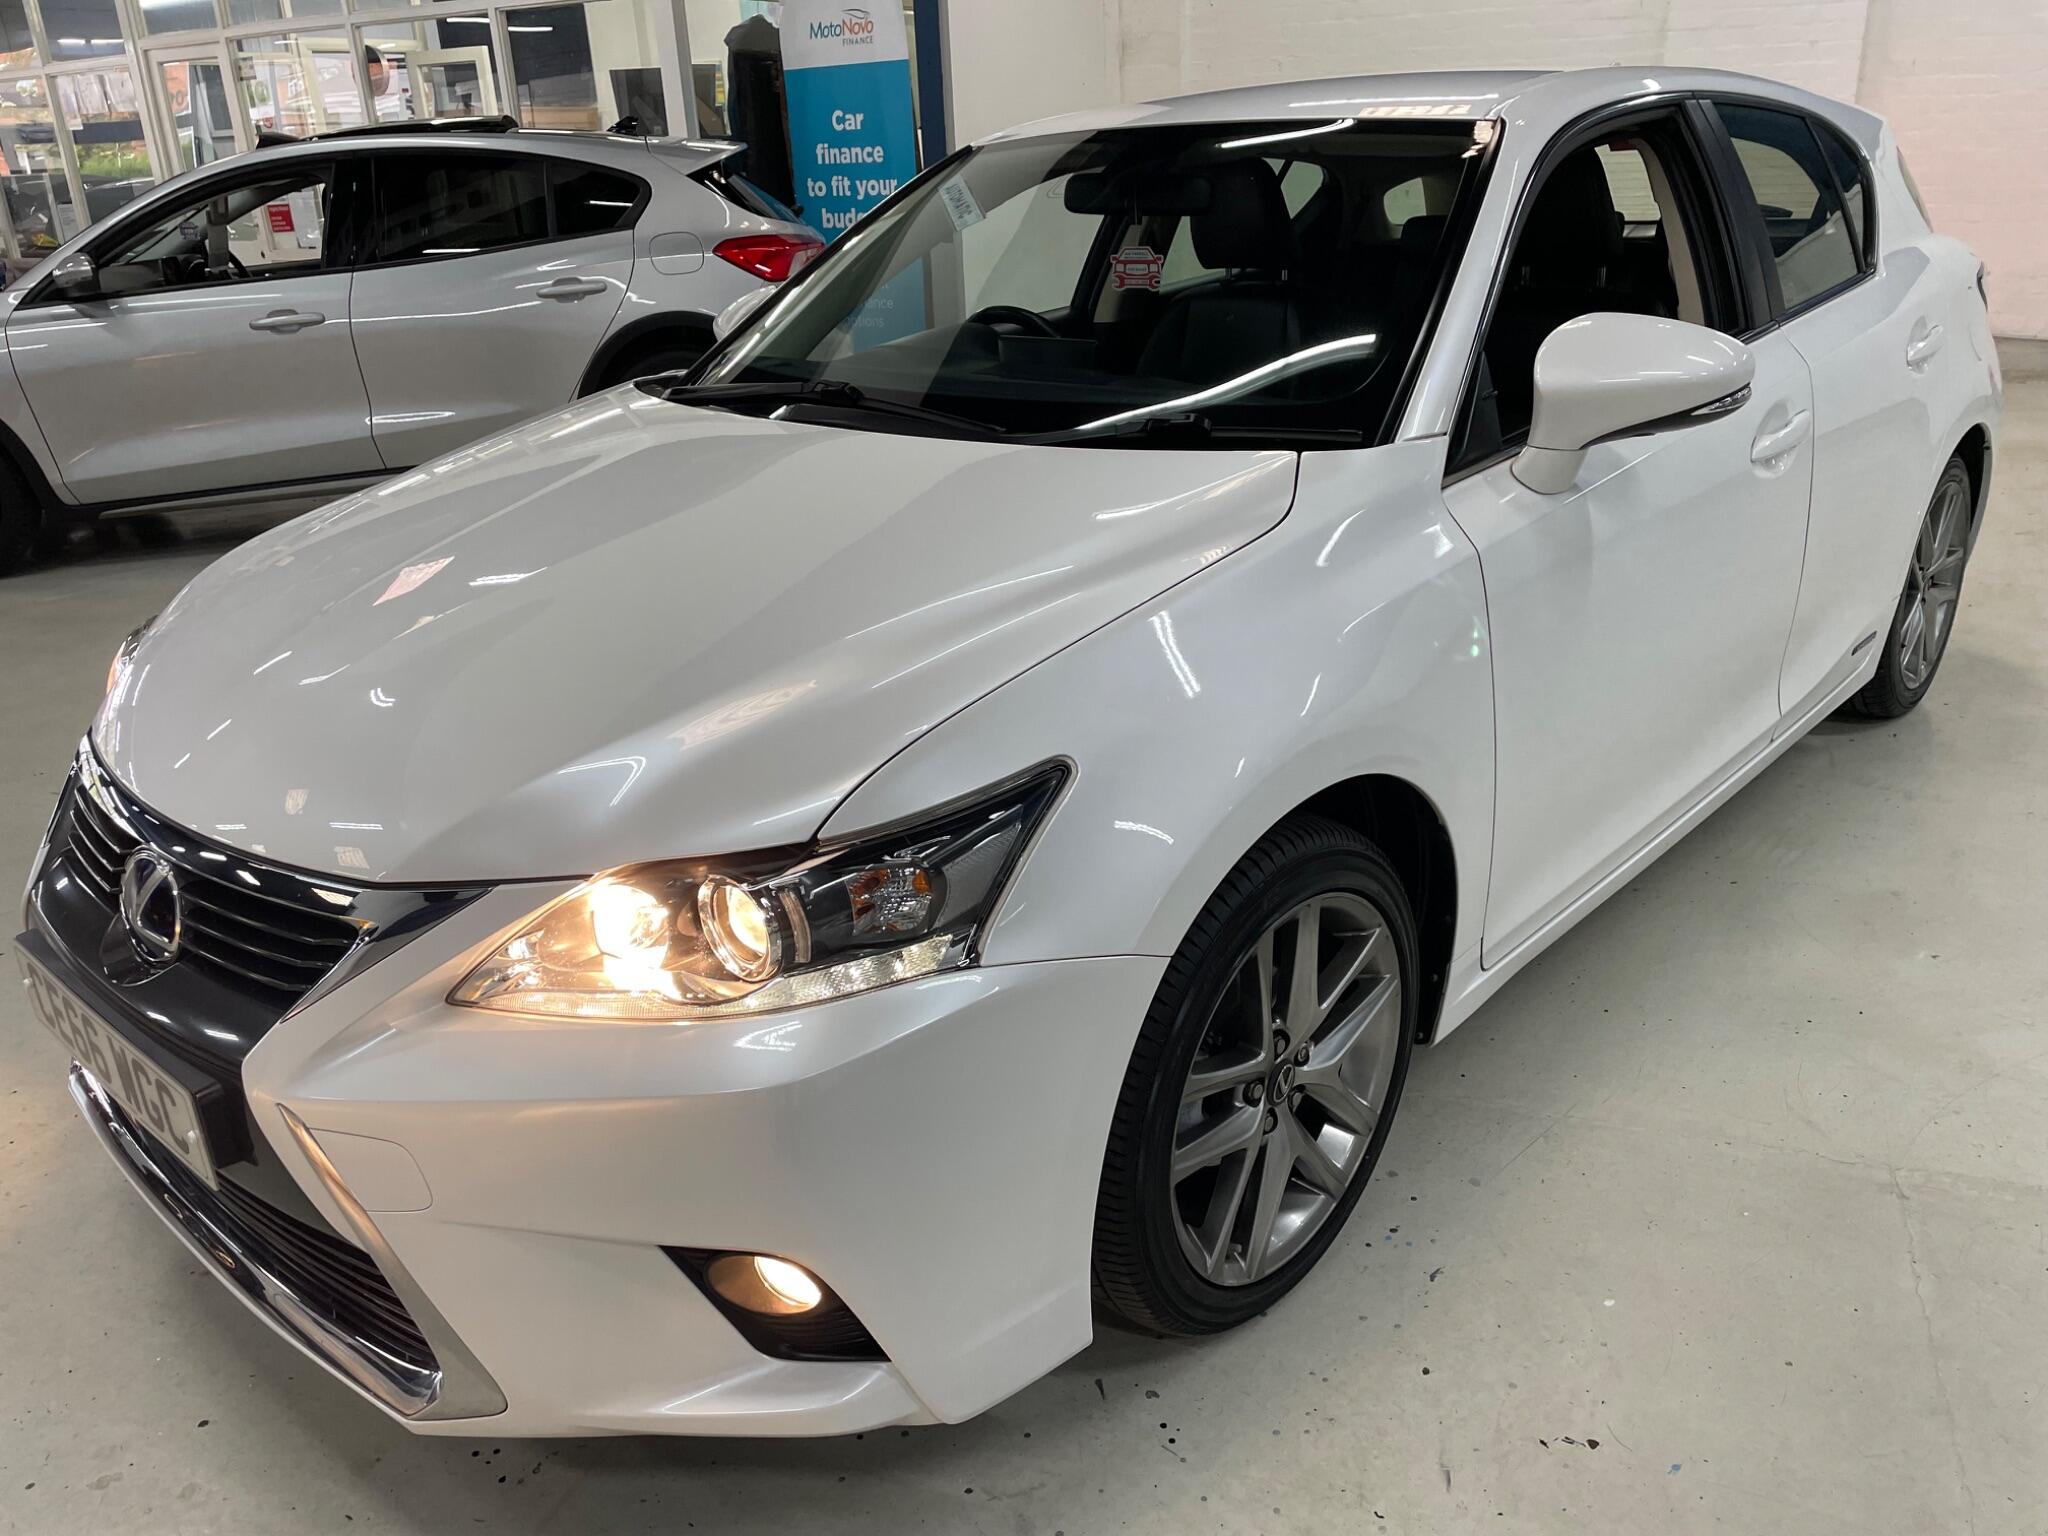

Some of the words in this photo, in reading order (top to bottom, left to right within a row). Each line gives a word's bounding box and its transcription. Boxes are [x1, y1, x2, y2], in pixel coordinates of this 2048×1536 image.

[809, 18, 874, 40] MotoNovo
[842, 36, 874, 46] FINANCE
[831, 109, 864, 131] Car
[816, 143, 884, 164] finance
[807, 178, 827, 197] to
[831, 175, 851, 196] fit
[855, 178, 898, 200] your
